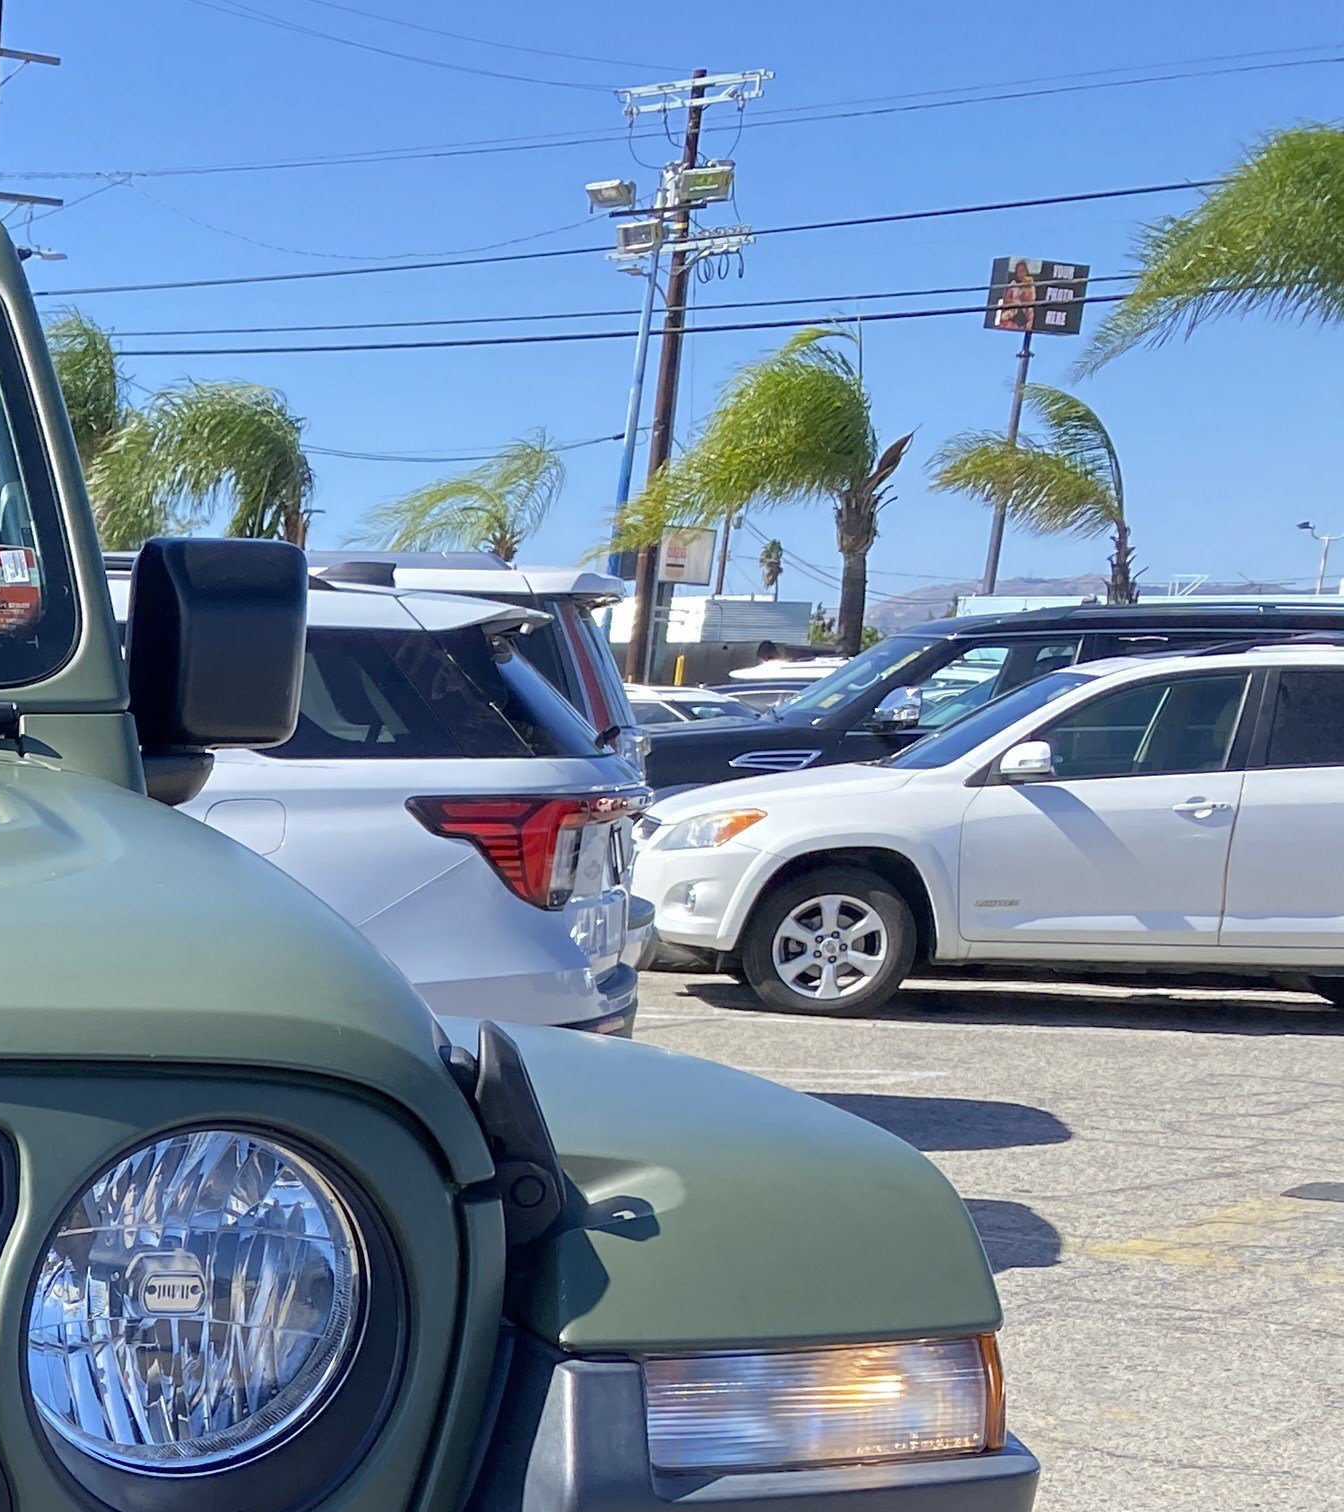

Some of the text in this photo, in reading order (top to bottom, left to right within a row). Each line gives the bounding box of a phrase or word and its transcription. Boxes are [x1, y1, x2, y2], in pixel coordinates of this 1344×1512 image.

[1053, 264, 1075, 280] YOUR
[1045, 286, 1074, 302] PHOTO
[1045, 310, 1067, 326] HERE
